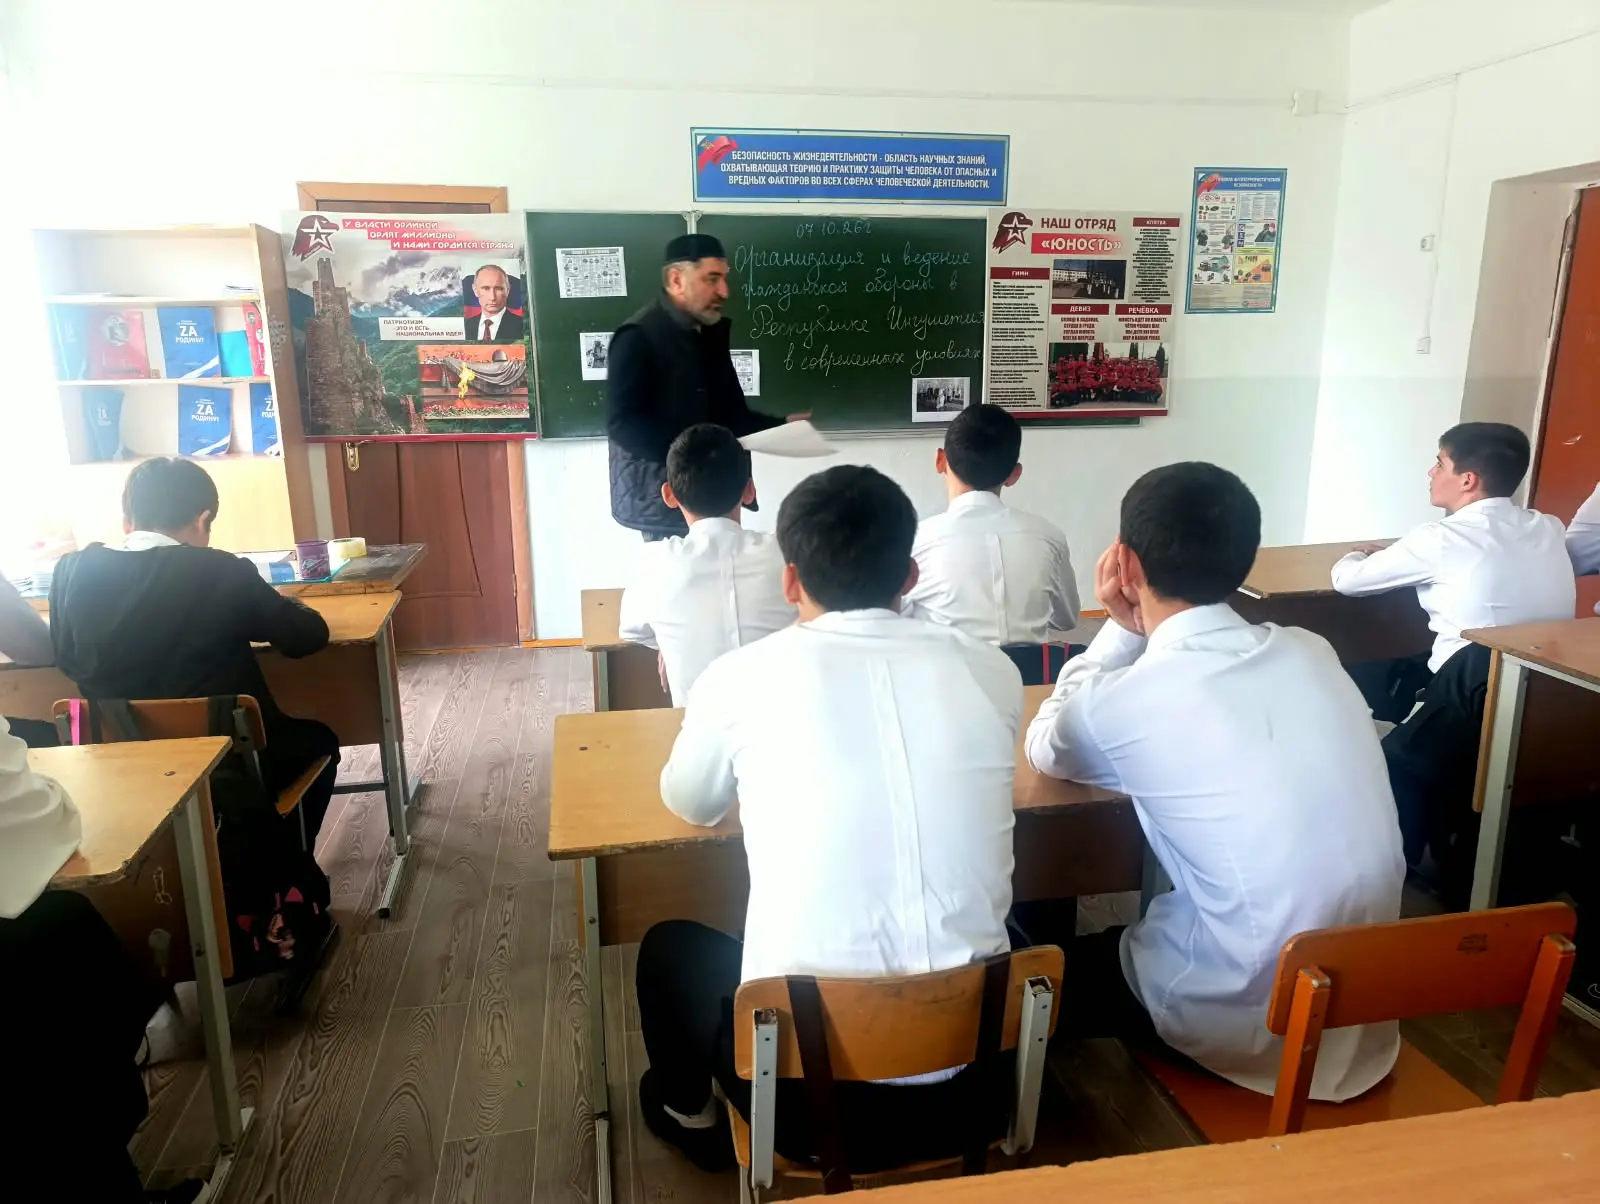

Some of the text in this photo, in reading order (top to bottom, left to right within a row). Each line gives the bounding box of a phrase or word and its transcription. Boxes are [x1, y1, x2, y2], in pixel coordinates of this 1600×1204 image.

[731, 151, 791, 161] БЕЗОПАСНОСТЬ
[793, 152, 878, 163] ЖИЗНЕДЕЯТЕЛЬНОСТИ
[885, 153, 918, 163] ОБЛАСТЬ
[920, 154, 955, 164] НАУЧНЫХ
[957, 154, 986, 165] ЗНАНИЙ,
[720, 162, 997, 177] ОХВАТЫВАЮЩАЯ ТЕОРИЮ И ПРАКТИКУ ЗАЩИТЫ ЧЕЛОВЕКА ОТ ОПАСНЫХ И
[729, 175, 991, 189] ВРЕДНЫХ ФАКТОРОВ ВО ВСЕХ СФЕРАХ ЧЕЛОВЕЧЕСКОЙ ДЕЯТЕЛЬНОСТИ.
[344, 221, 352, 229] У
[354, 221, 391, 229] ВЛАСТИ
[1040, 217, 1117, 231] НАШ ОТРЯД
[371, 231, 457, 240] ОРЛЯТ МИЛЛИОНЫ
[402, 241, 431, 249] НАМИ
[432, 241, 478, 249] ГОРДИТСЯ
[480, 241, 515, 249] СТРАНА
[1041, 237, 1122, 251] «ЮНОСТЬ»
[735, 240, 972, 287] Организация и ведение
[865, 268, 934, 302] обороны
[949, 270, 958, 291] в
[1069, 305, 1092, 313] ДЕВИЗ
[1128, 305, 1160, 314] РЕЧЁВКА
[179, 325, 199, 337] ZA
[749, 304, 870, 349] Республике
[784, 342, 795, 371] в
[196, 403, 214, 415] ZA
